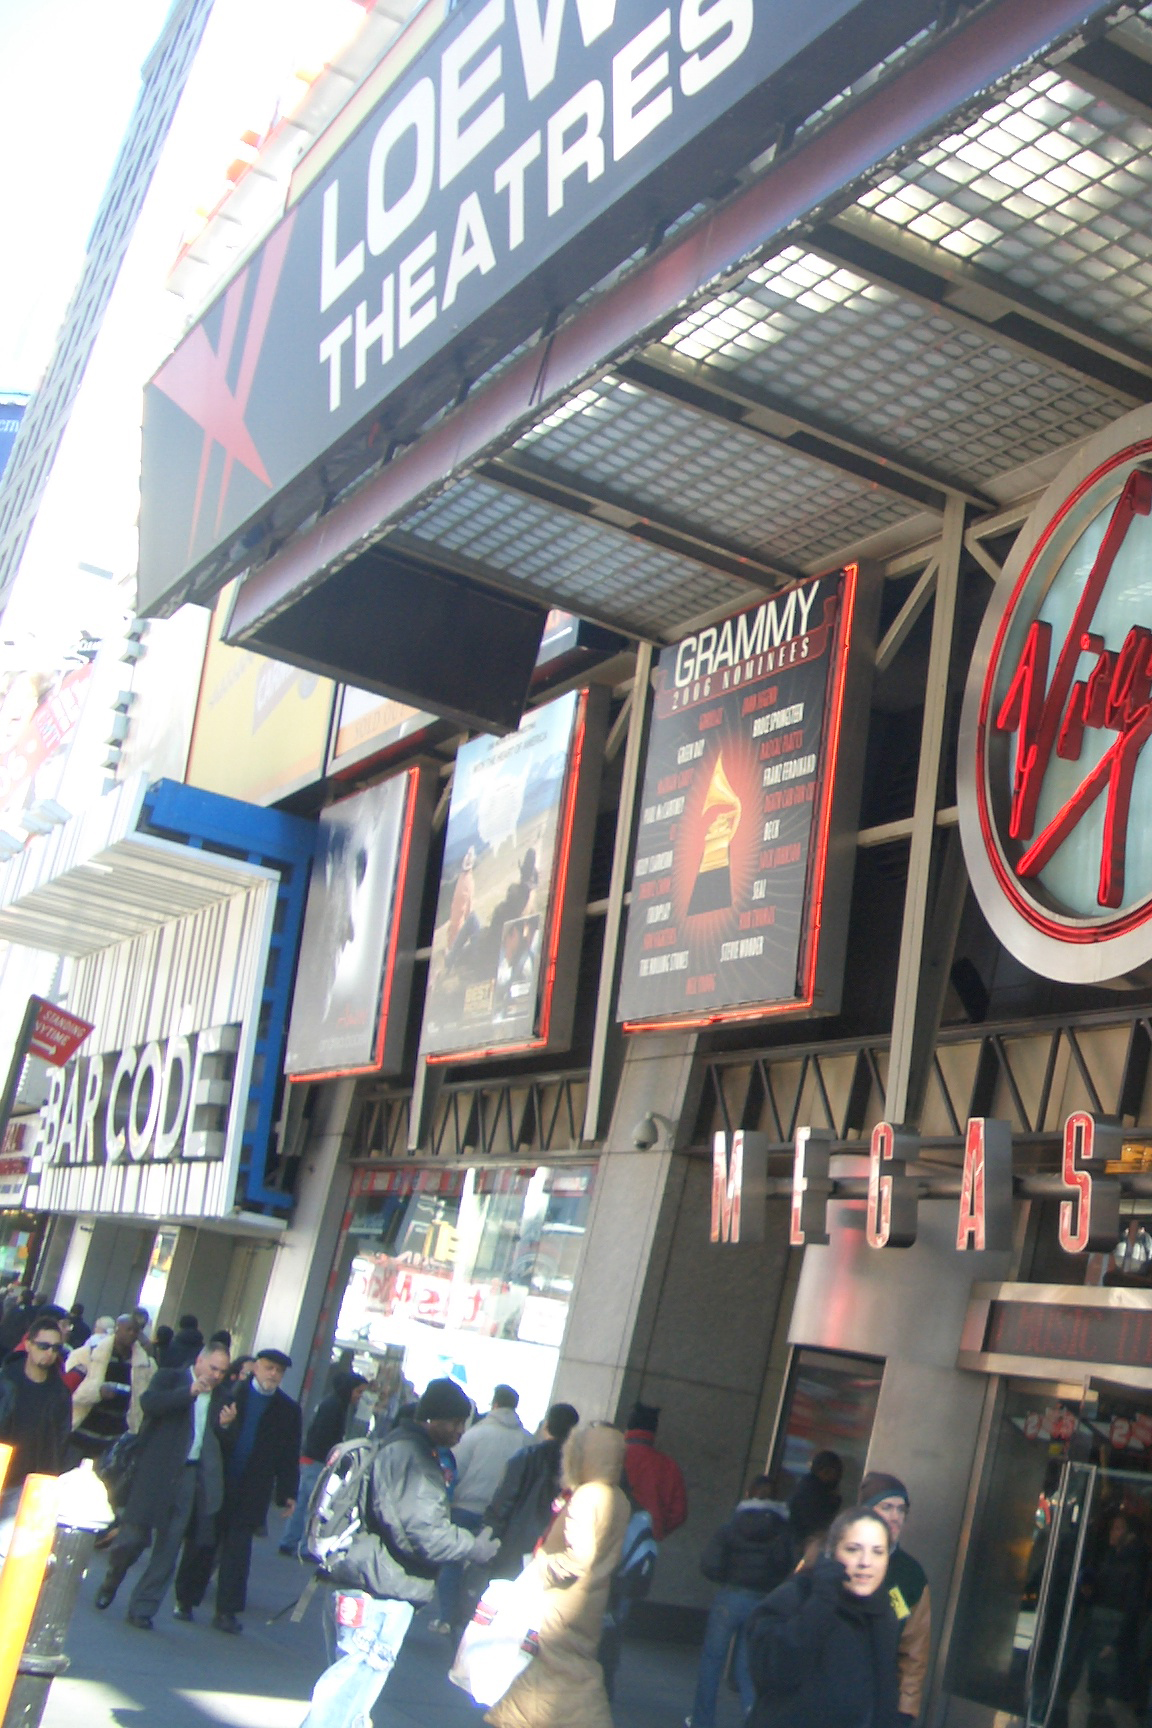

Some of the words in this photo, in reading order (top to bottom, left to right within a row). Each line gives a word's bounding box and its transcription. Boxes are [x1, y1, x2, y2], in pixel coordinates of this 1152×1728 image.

[319, 0, 754, 413] THEATRES
[671, 677, 711, 711] 2006
[722, 636, 809, 690] NOMINEES
[674, 580, 820, 688] GRAMMY
[35, 1020, 71, 1047] NYTIME
[41, 1054, 104, 1164] BAR
[105, 1022, 241, 1163] CODE
